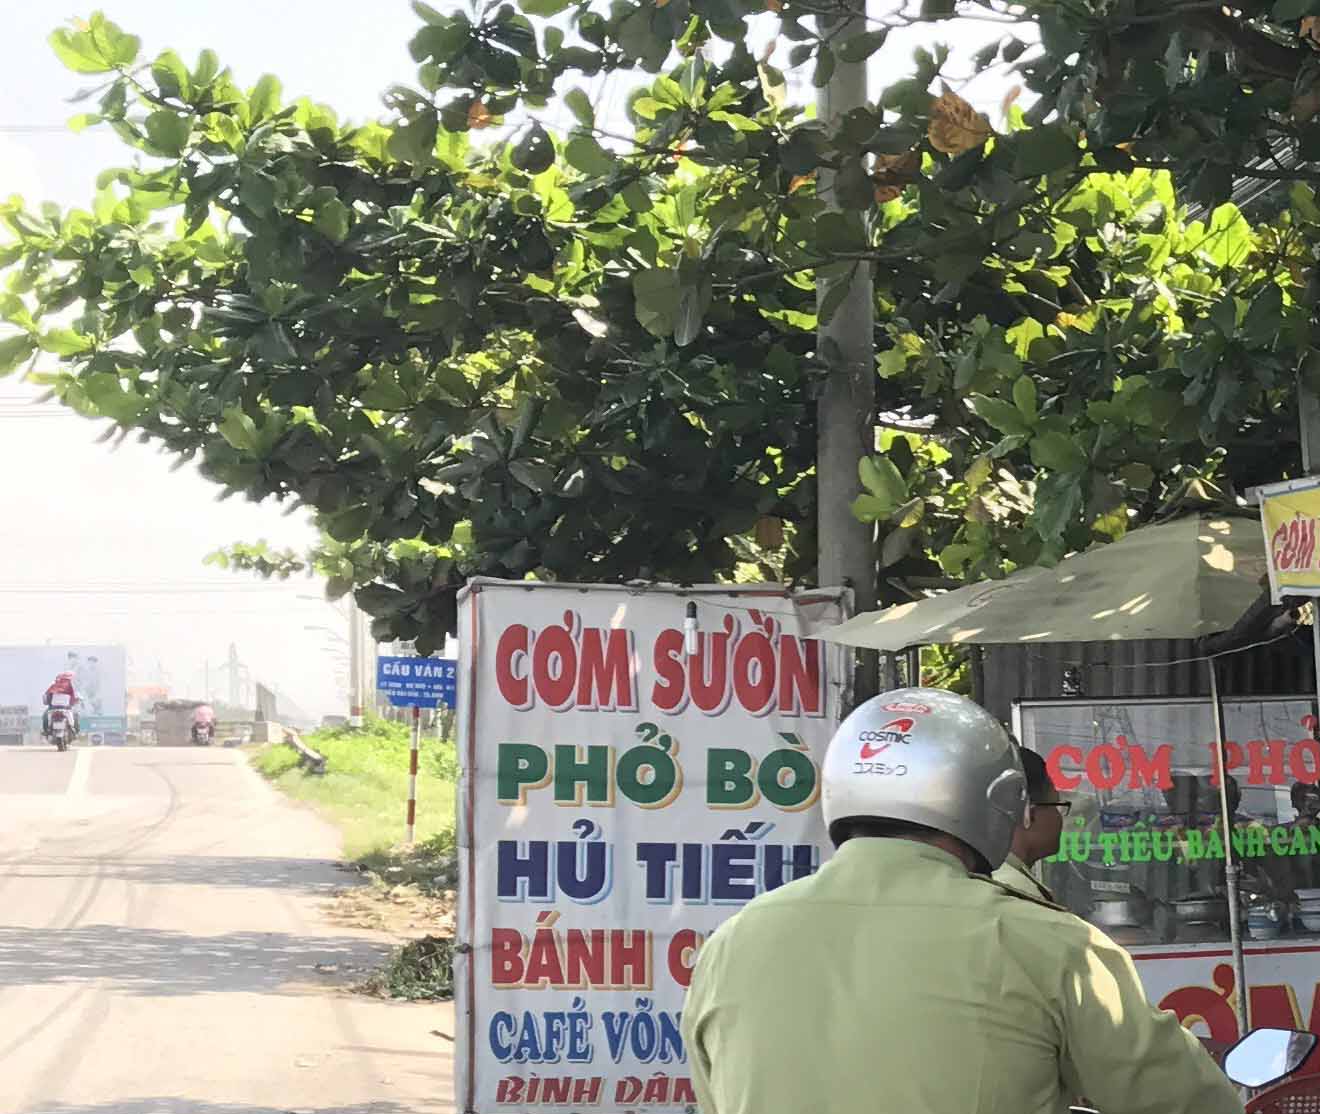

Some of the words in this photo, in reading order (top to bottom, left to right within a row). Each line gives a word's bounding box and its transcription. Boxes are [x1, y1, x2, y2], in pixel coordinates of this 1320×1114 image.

[496, 609, 639, 713] CƠM
[651, 608, 826, 718] SƯỜN
[497, 722, 683, 810] PHỞ
[707, 732, 821, 812] BÒ
[859, 731, 912, 744] COSMIC
[1046, 735, 1174, 790] CƠM
[497, 819, 613, 904] HỦ
[636, 822, 819, 905] TIẾU
[491, 910, 653, 990] BÁNH
[489, 997, 593, 1064] CAFÉ
[602, 997, 687, 1063] VÕN
[496, 1072, 605, 1106] BÌNH
